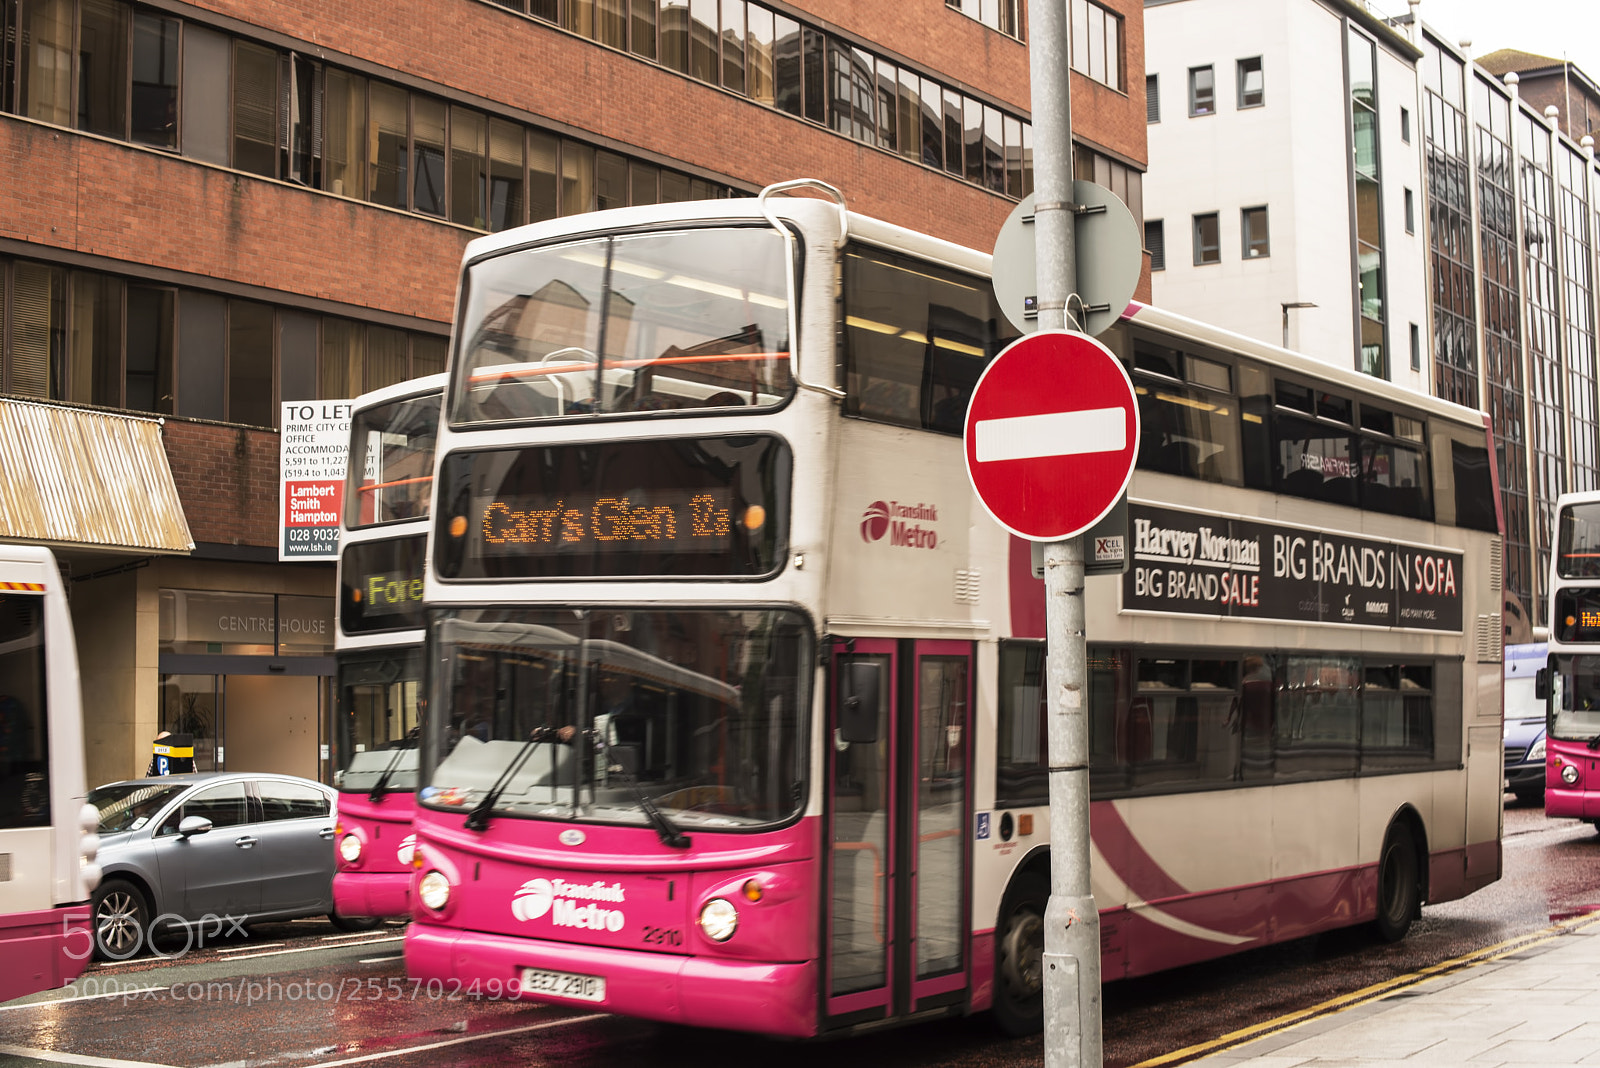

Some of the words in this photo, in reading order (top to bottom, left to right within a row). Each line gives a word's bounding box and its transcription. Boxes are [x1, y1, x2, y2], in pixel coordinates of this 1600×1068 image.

[286, 405, 314, 421] TO
[322, 404, 353, 420] LET
[286, 424, 313, 433] PRIME
[316, 423, 335, 432] CITY
[286, 434, 316, 444] OFFICE
[285, 457, 307, 466] 5,591
[309, 457, 318, 465] to
[321, 456, 348, 466] 11,227
[284, 468, 309, 478] (519.4
[312, 468, 321, 477] to
[324, 467, 345, 476] 1,043
[290, 484, 335, 498] Lambert
[290, 497, 321, 510] Smith
[889, 500, 939, 522] Translink
[290, 511, 338, 525] Hampton
[482, 500, 585, 544] Carr's
[590, 497, 678, 542] Glen
[290, 529, 310, 541] 028
[313, 529, 341, 541] 9032
[890, 519, 938, 550] Metro
[1134, 518, 1198, 566] Harvey
[1199, 526, 1260, 566] Norman
[289, 543, 332, 553] www.lsh.ie
[1274, 534, 1307, 580] BIG
[1312, 540, 1386, 590] BRANDS
[1390, 550, 1410, 592] IN
[1414, 553, 1457, 597] SOFA
[1135, 567, 1163, 598] BIG
[1167, 570, 1219, 601] BRAND
[1221, 571, 1259, 608] SALE
[218, 615, 275, 632] CENTRE
[279, 618, 326, 634] HOUSE
[551, 878, 626, 903] Translink
[552, 898, 625, 932] Metro
